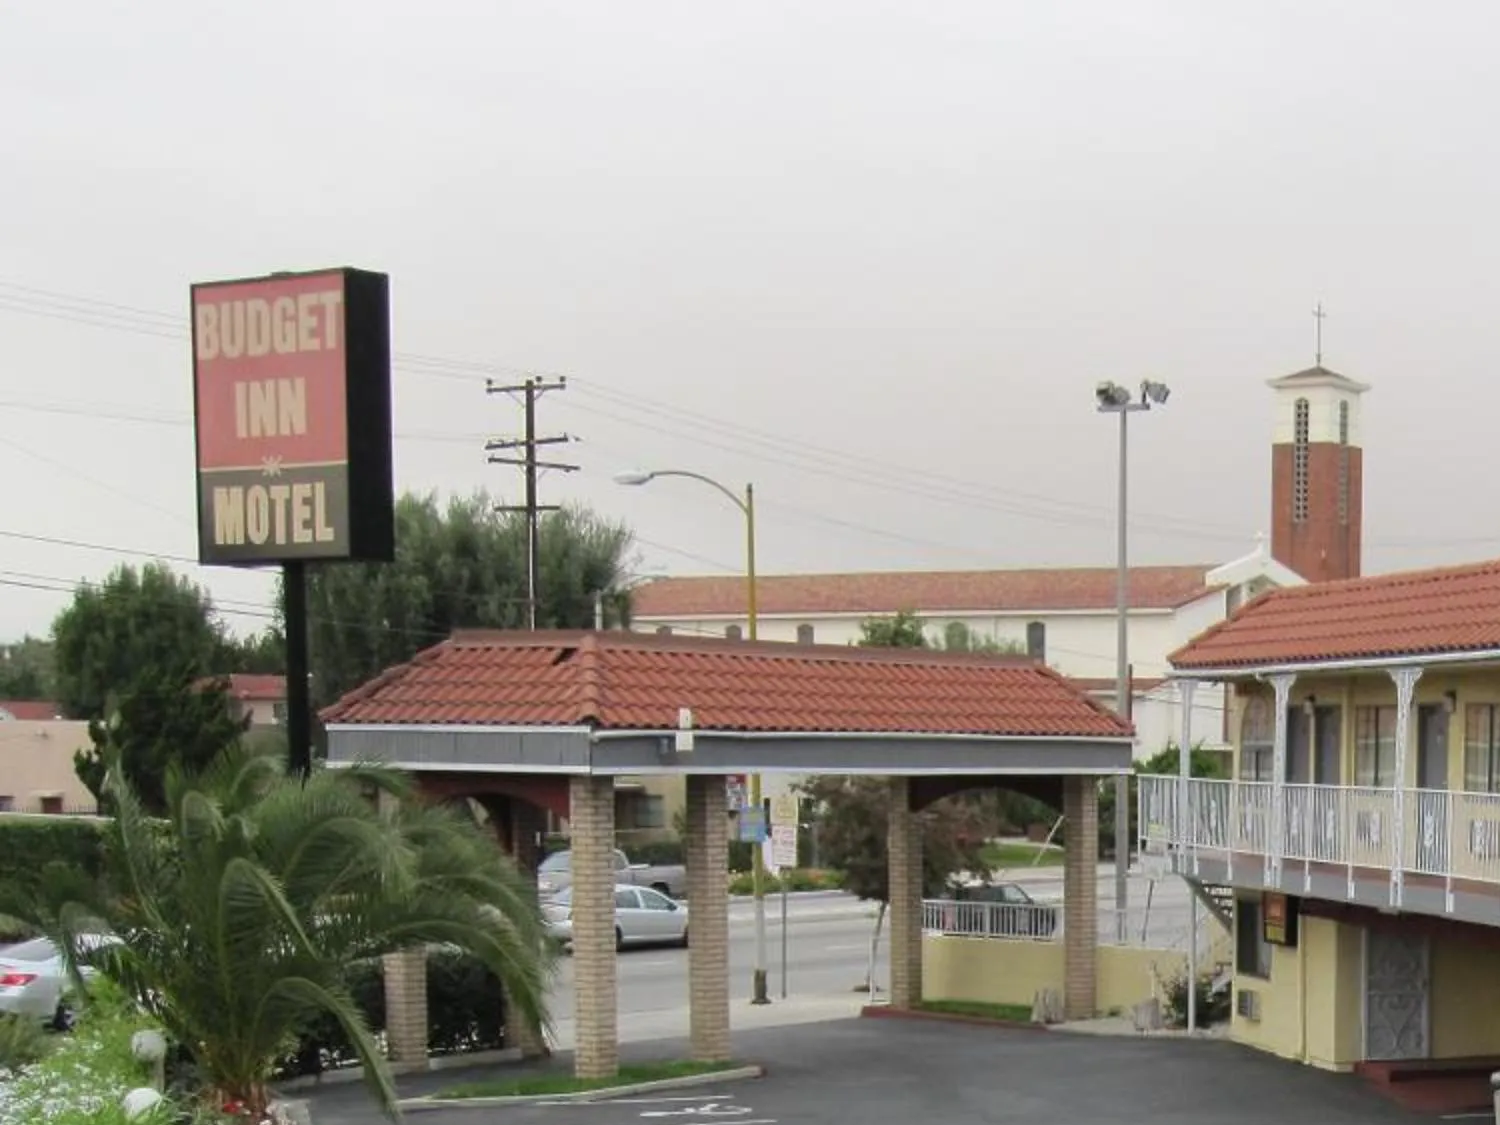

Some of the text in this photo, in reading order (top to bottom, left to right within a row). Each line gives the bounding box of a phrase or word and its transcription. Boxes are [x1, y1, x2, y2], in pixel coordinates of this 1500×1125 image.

[197, 290, 342, 360] BUDGET
[235, 377, 306, 439] INN
[213, 481, 335, 546] MOTEL
